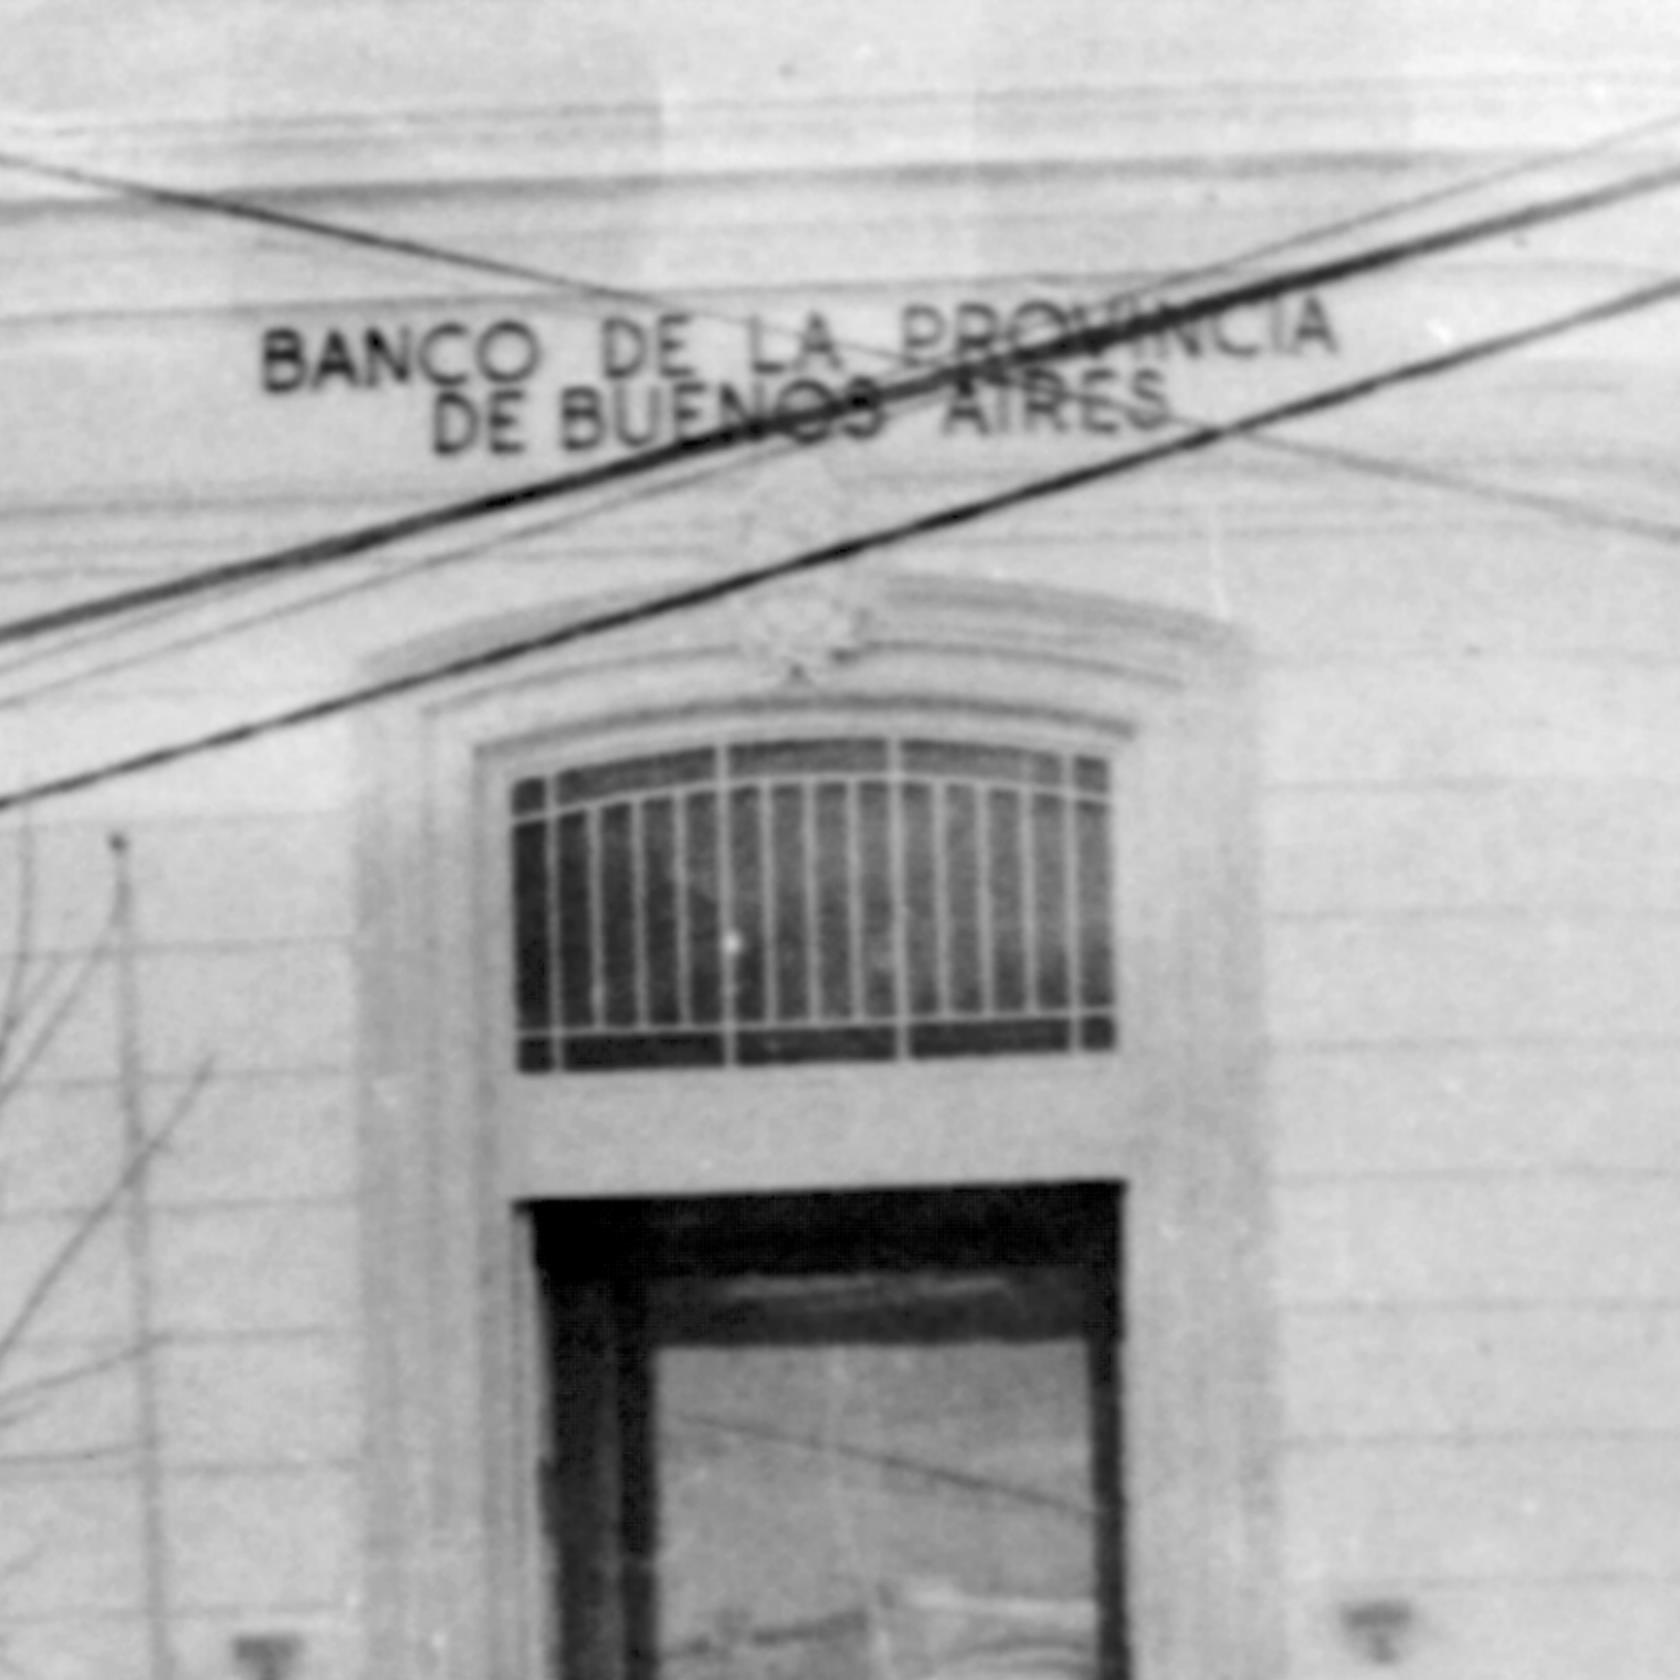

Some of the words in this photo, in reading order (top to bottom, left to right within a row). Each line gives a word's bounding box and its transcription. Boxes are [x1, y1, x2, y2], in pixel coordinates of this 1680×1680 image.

[261, 319, 539, 394] BANCO
[603, 313, 694, 380] DE
[750, 309, 843, 374] LA
[432, 389, 525, 456] DE
[559, 376, 886, 451] BUENOS
[941, 366, 1172, 438] AIRES
